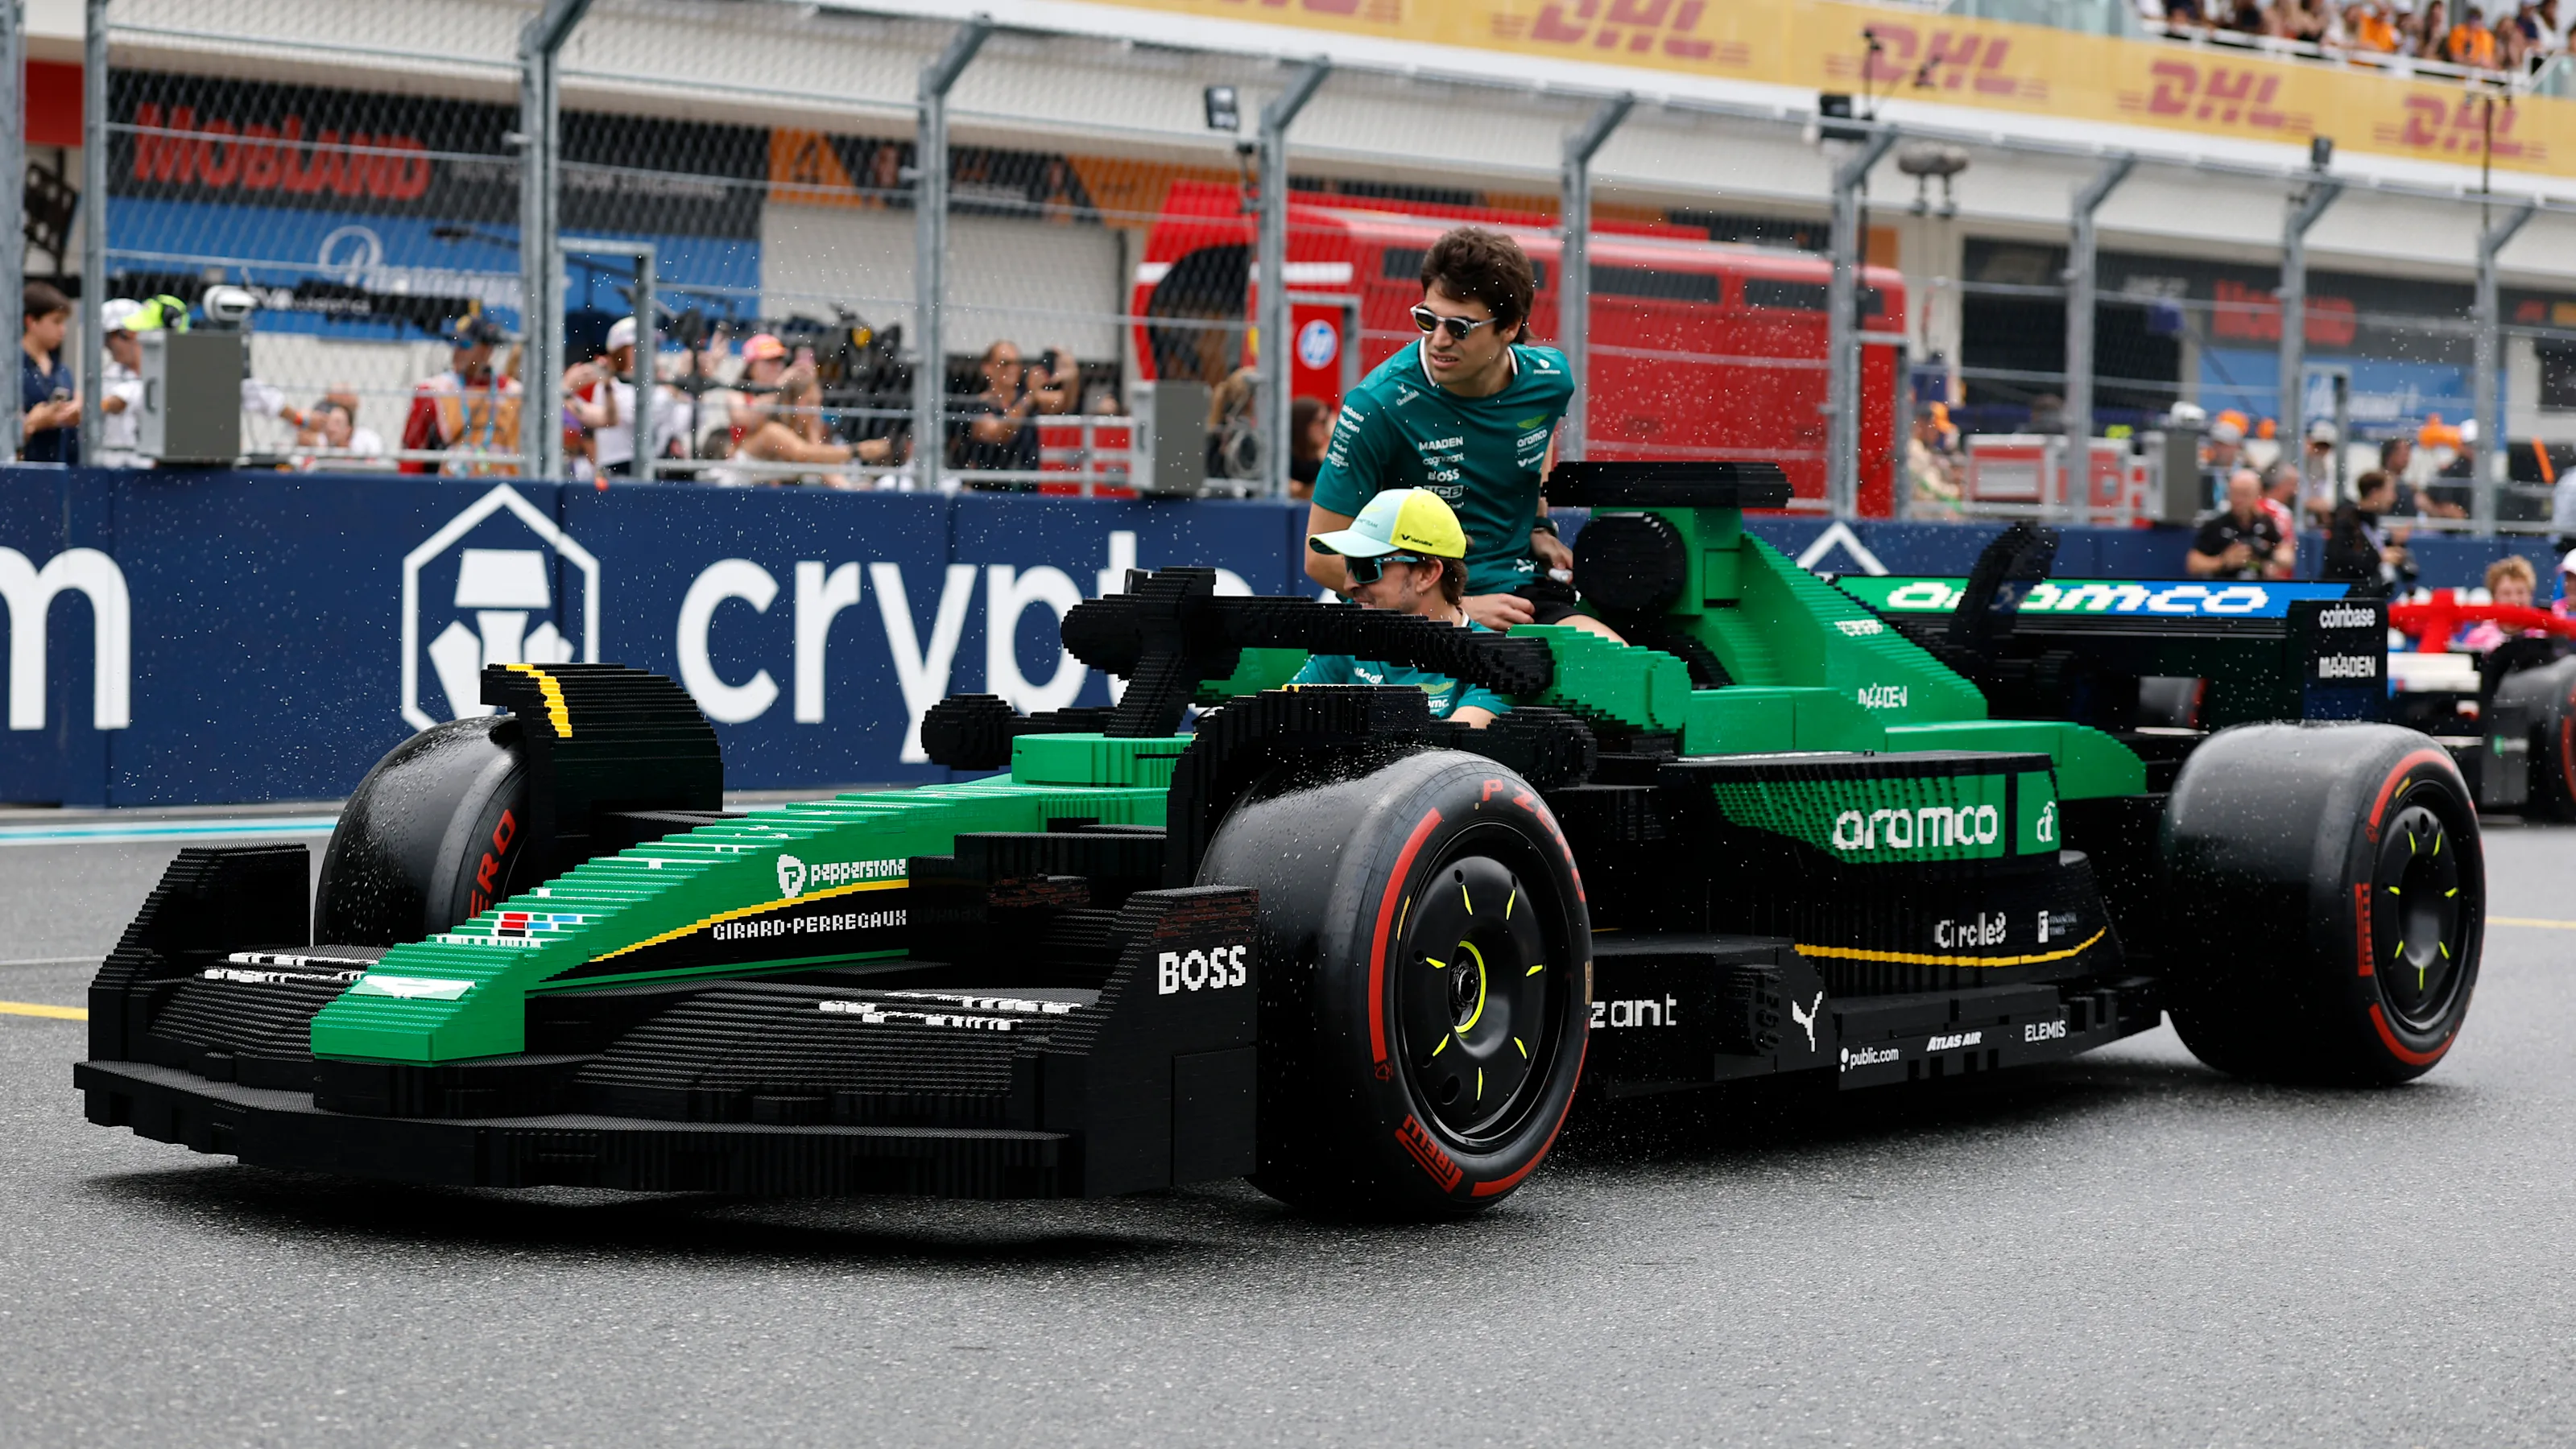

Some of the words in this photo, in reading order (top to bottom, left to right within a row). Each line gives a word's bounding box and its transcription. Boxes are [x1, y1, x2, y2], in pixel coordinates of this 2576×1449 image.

[1531, 0, 1714, 60] DHL
[1860, 23, 2016, 95] DHL
[2148, 60, 2286, 129] DHL
[2402, 96, 2523, 156] DHL
[1422, 452, 1465, 467] cognizant
[1517, 429, 1547, 448] aramco
[1428, 469, 1460, 481] BOSS
[2319, 602, 2375, 629] coinbase
[676, 530, 1256, 763] crypt
[1482, 779, 1504, 802] P
[1512, 786, 1586, 902] ZERO
[1833, 805, 1997, 850] aramco
[811, 859, 906, 886] pepperstone
[1159, 945, 1246, 995] BOSS
[1926, 1034, 1962, 1051] ATLAS
[1962, 1031, 1982, 1046] AIR
[2024, 1020, 2066, 1042] ELEMIS
[1850, 1047, 1900, 1069] public.com
[1395, 1113, 1463, 1193] PIRELLI
